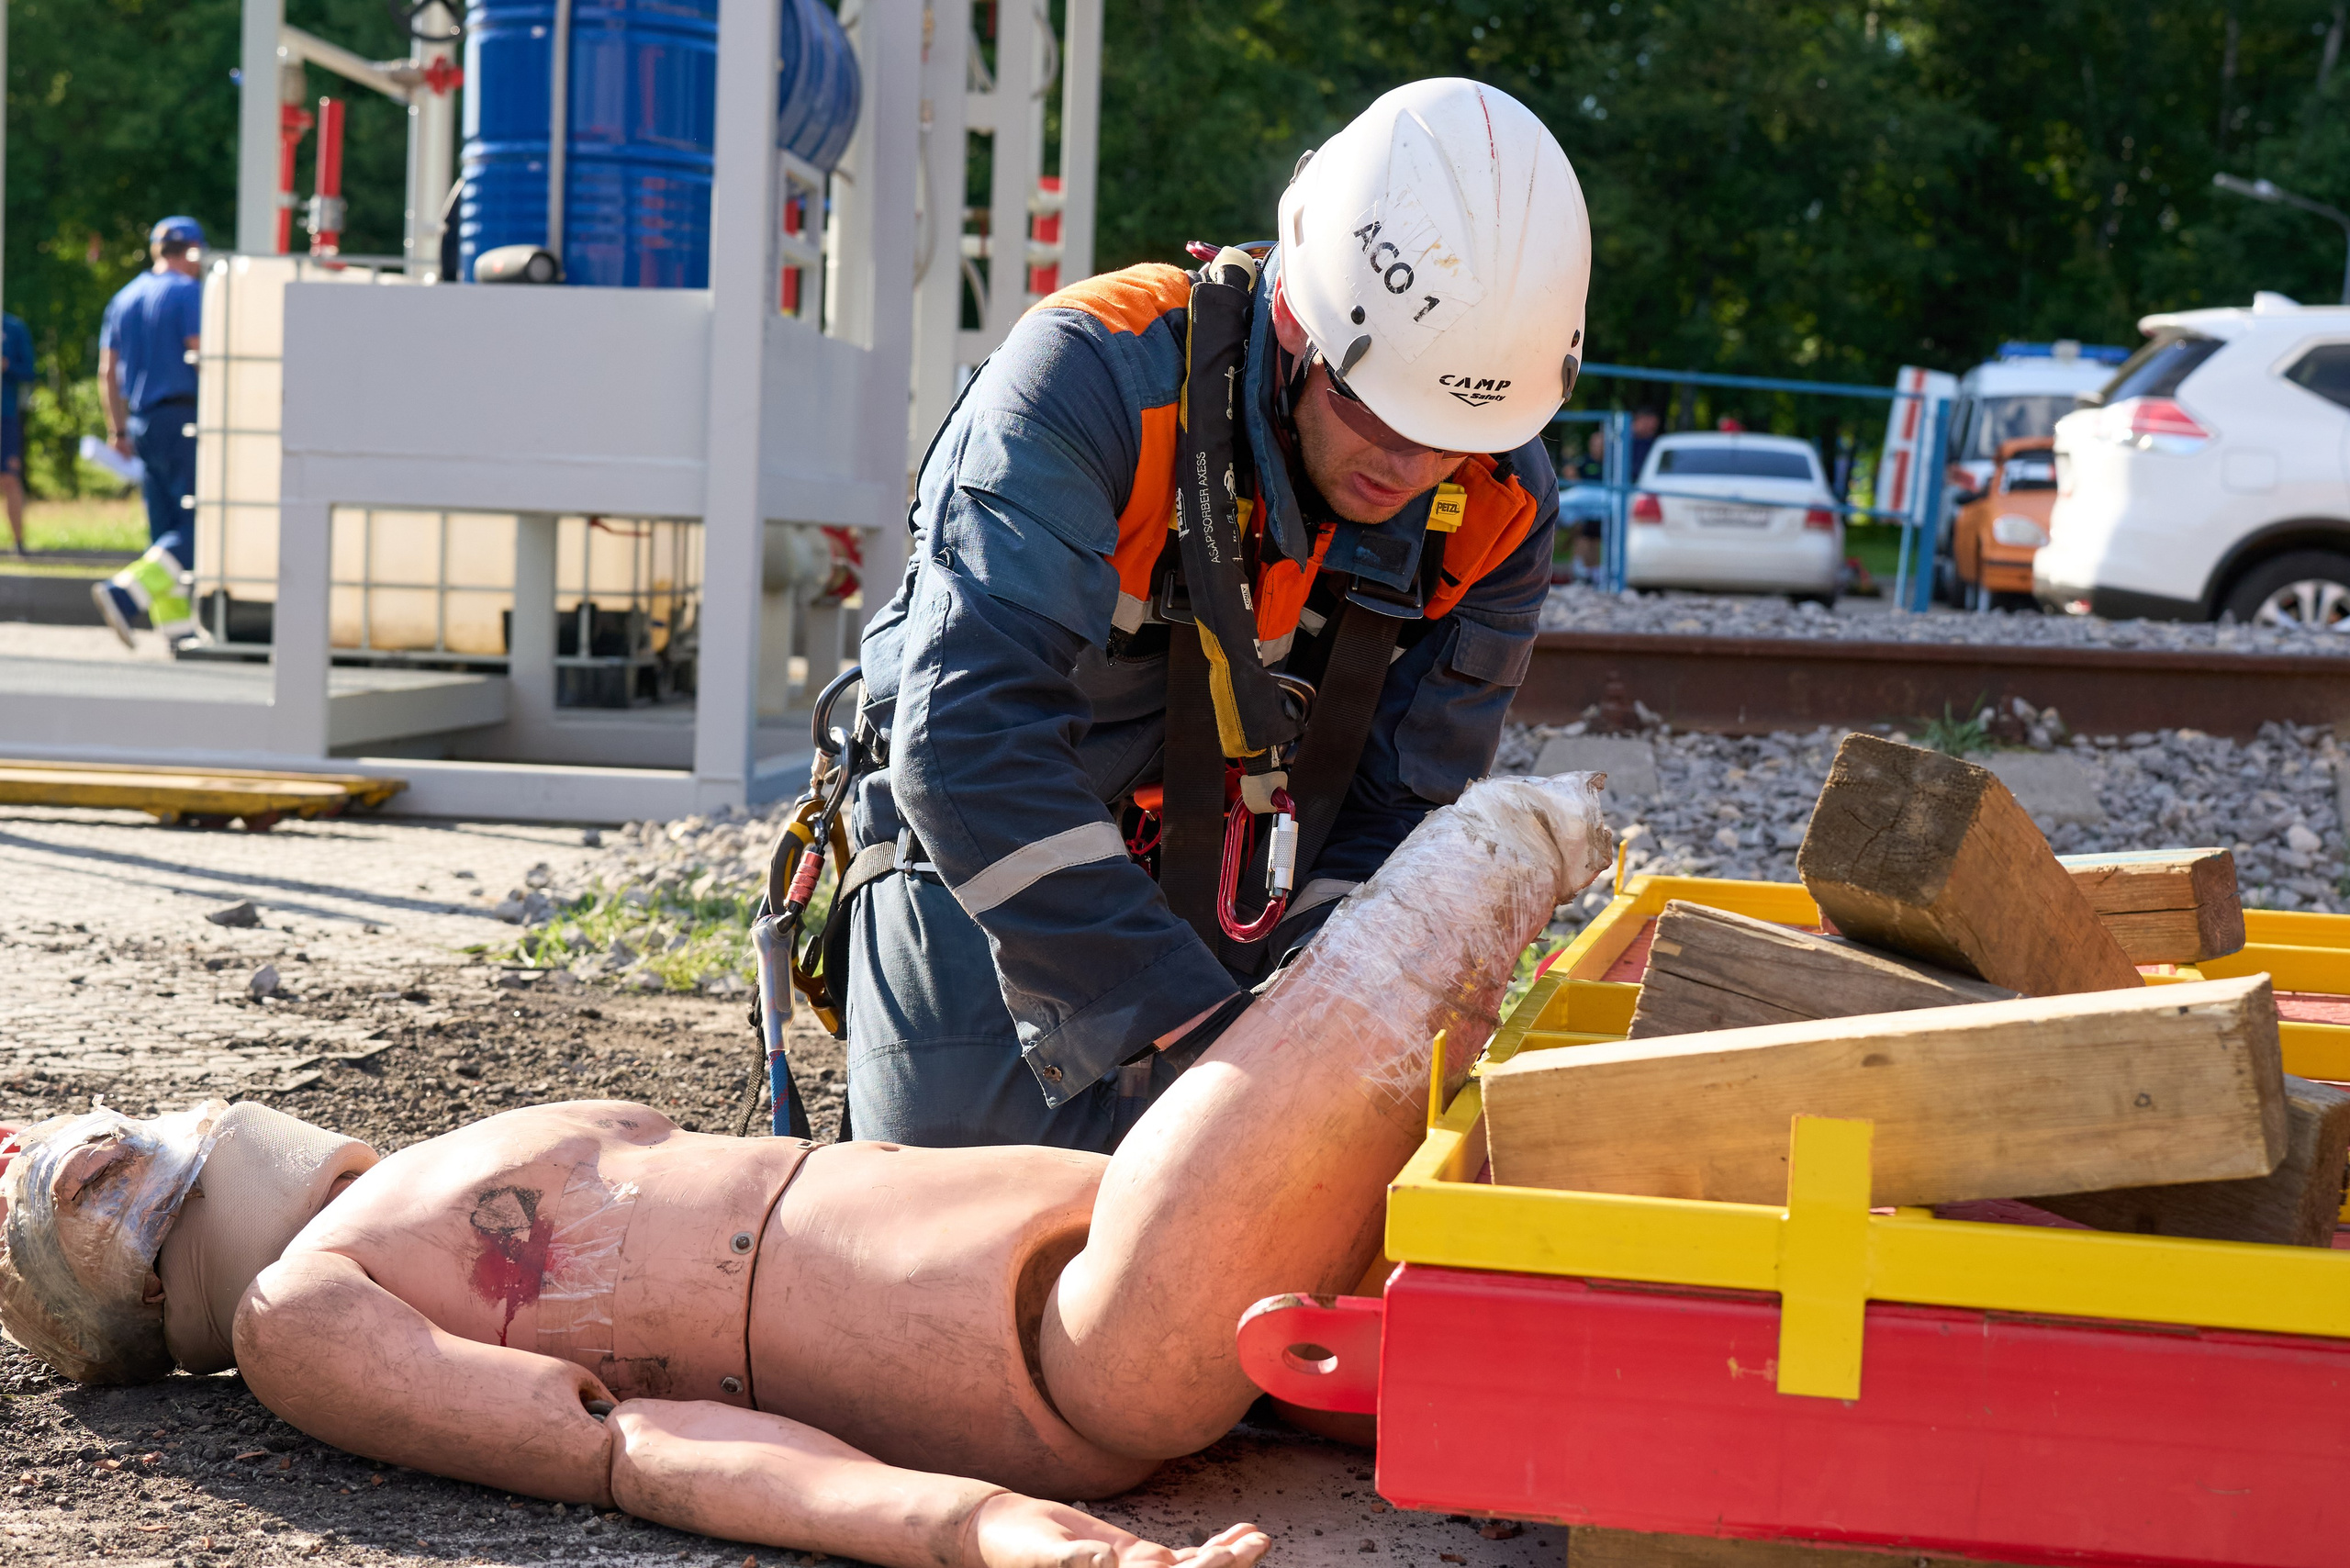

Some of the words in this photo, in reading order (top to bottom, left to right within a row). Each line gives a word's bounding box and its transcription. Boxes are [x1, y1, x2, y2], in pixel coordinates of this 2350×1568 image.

[1414, 296, 1440, 322] 1
[1439, 375, 1511, 391] CAMP
[1470, 393, 1505, 401] Safety
[1196, 451, 1209, 487] AXESS
[1436, 501, 1460, 515] PETZL
